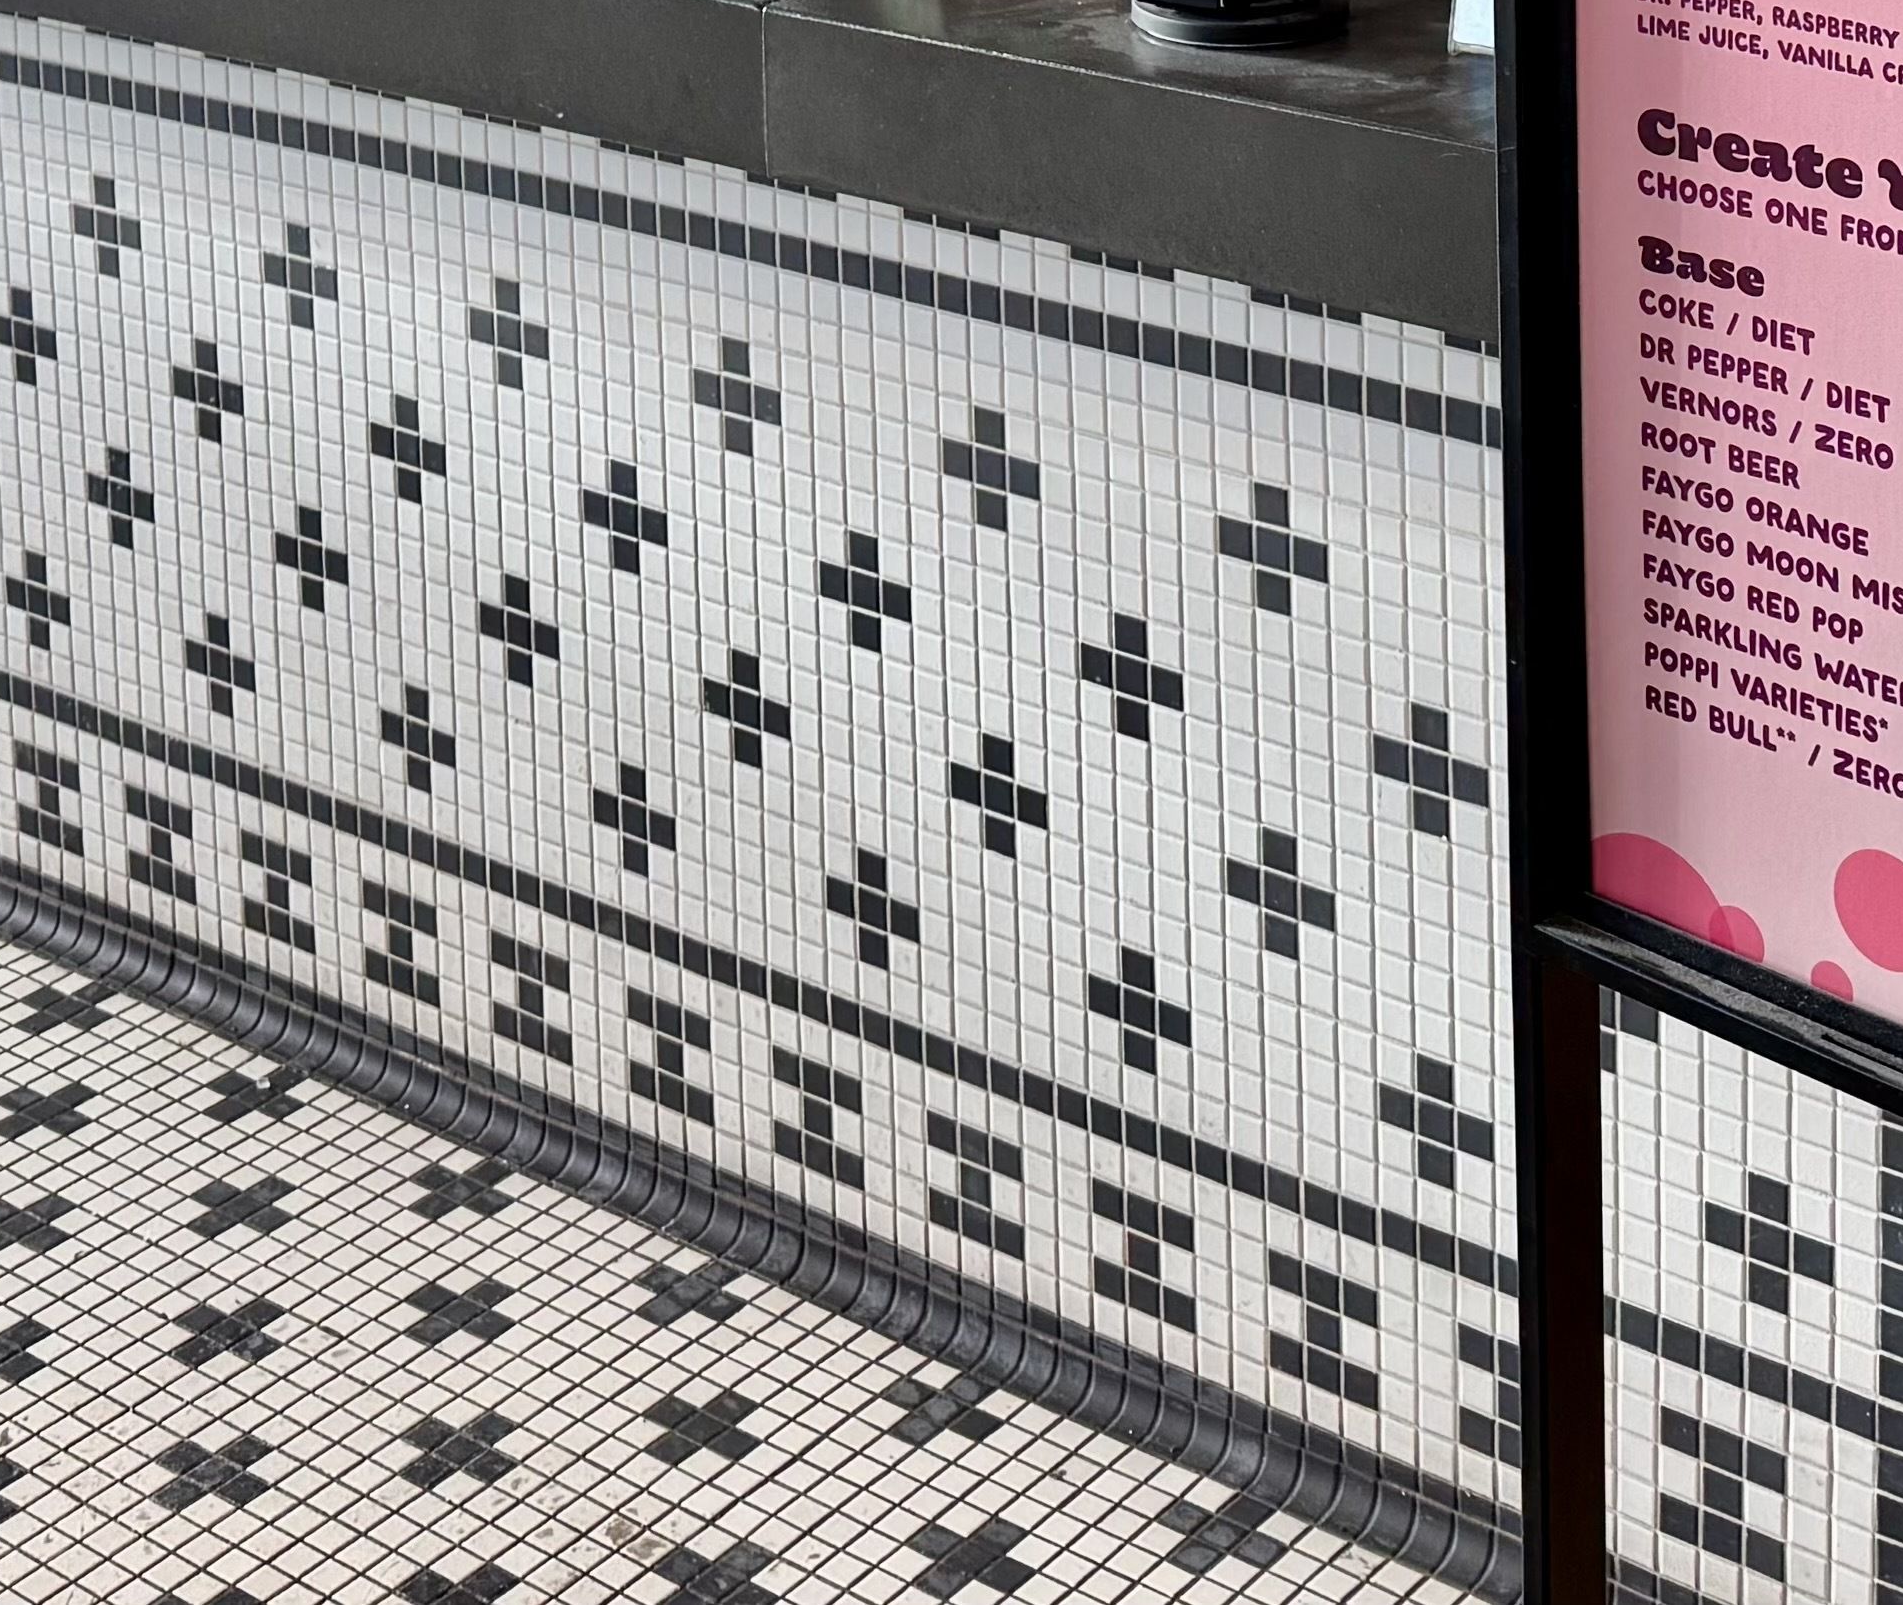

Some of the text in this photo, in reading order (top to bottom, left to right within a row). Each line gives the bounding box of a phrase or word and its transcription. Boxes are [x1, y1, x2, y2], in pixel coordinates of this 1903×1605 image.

[1637, 108, 1864, 199] Create
[1637, 169, 1753, 219] CHOOSE
[1764, 197, 1828, 237] ONE
[1637, 235, 1765, 298] Base
[1640, 421, 1801, 490] ROOT BEER
[1641, 465, 1869, 557] FAYGO ORANGE
